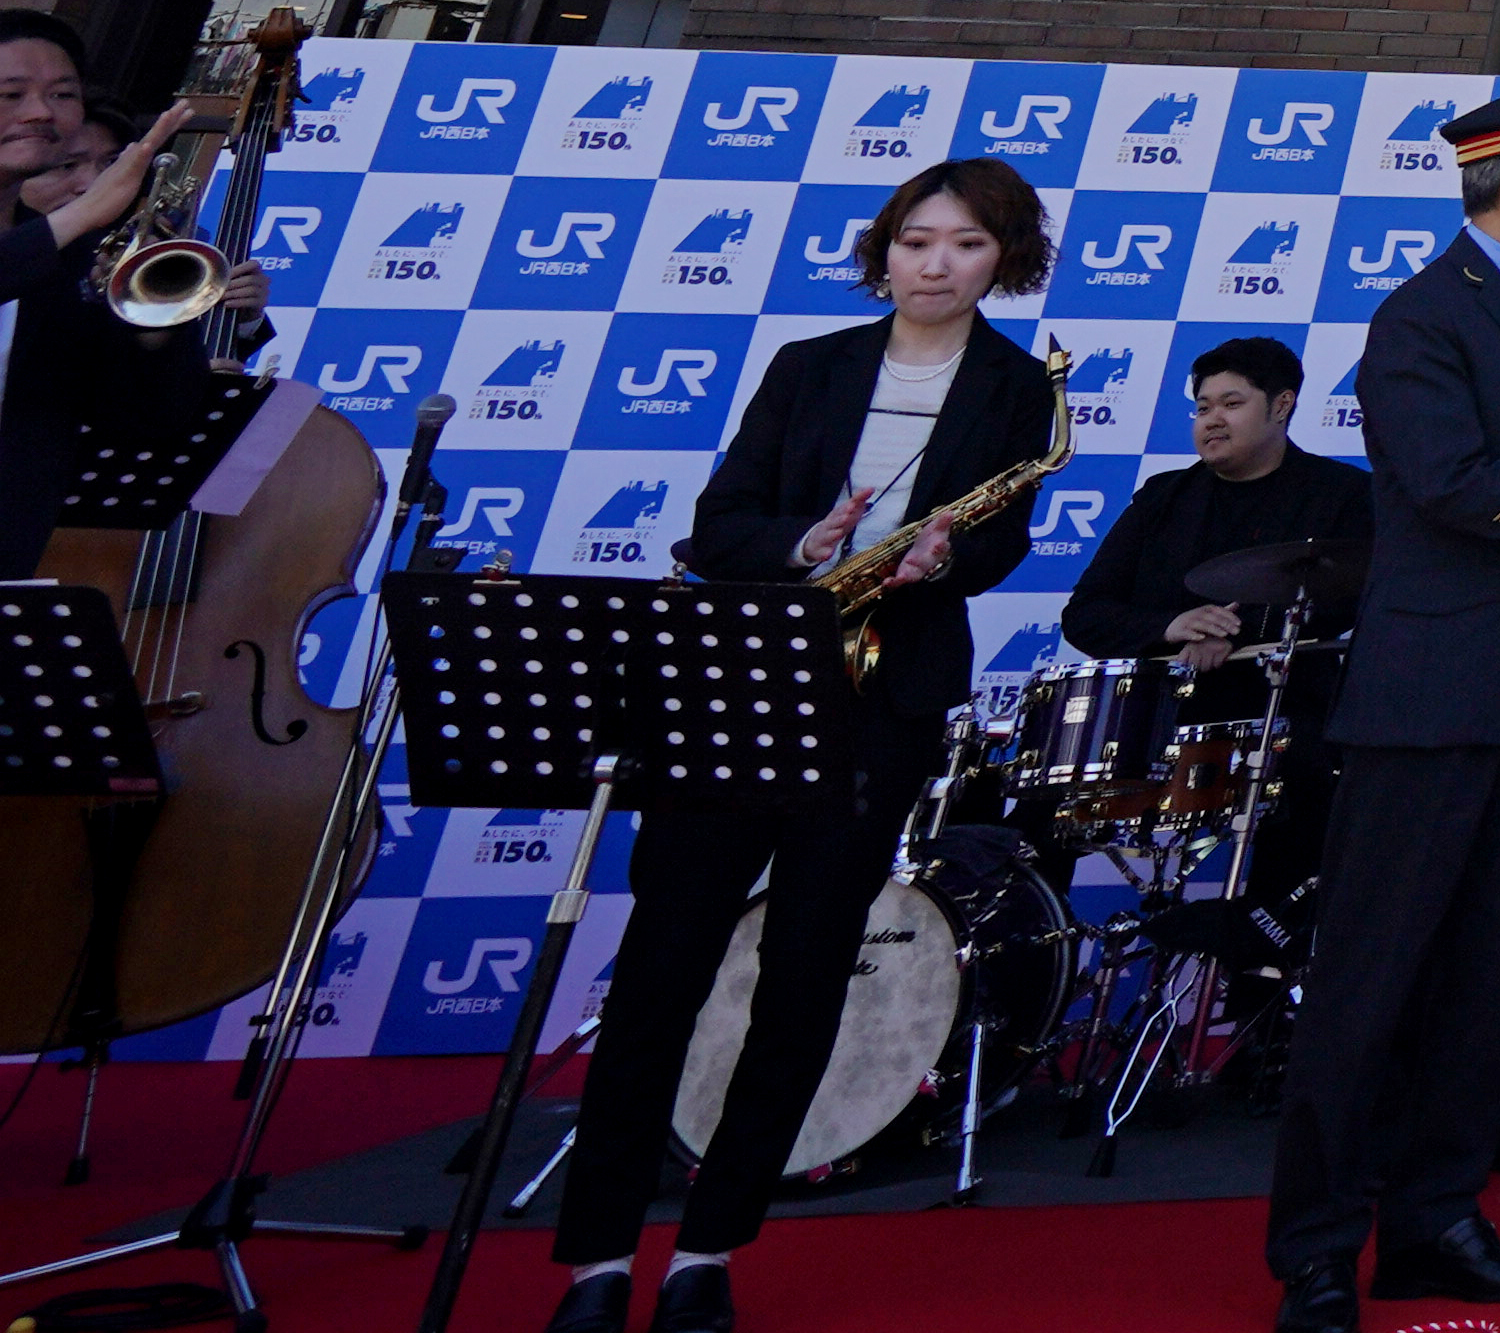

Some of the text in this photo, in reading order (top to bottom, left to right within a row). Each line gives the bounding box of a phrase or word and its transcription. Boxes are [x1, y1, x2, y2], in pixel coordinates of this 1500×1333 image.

[417, 79, 516, 123] JR
[704, 87, 798, 131] JR
[981, 95, 1071, 138] JR
[420, 126, 489, 139] JR西日本
[708, 134, 774, 146] JR西日本
[1247, 103, 1334, 145] JR
[985, 142, 1049, 154] JR西日本
[1252, 149, 1314, 161] JR西日本
[517, 212, 615, 258] JR
[1082, 225, 1172, 269] JR
[520, 262, 589, 275] JR西日本
[1087, 272, 1151, 285] JR西日本
[319, 346, 421, 393] JR
[618, 350, 717, 396] JR
[623, 401, 691, 413] JR西日本
[423, 937, 532, 994] JR
[426, 998, 504, 1015] JR西日本
